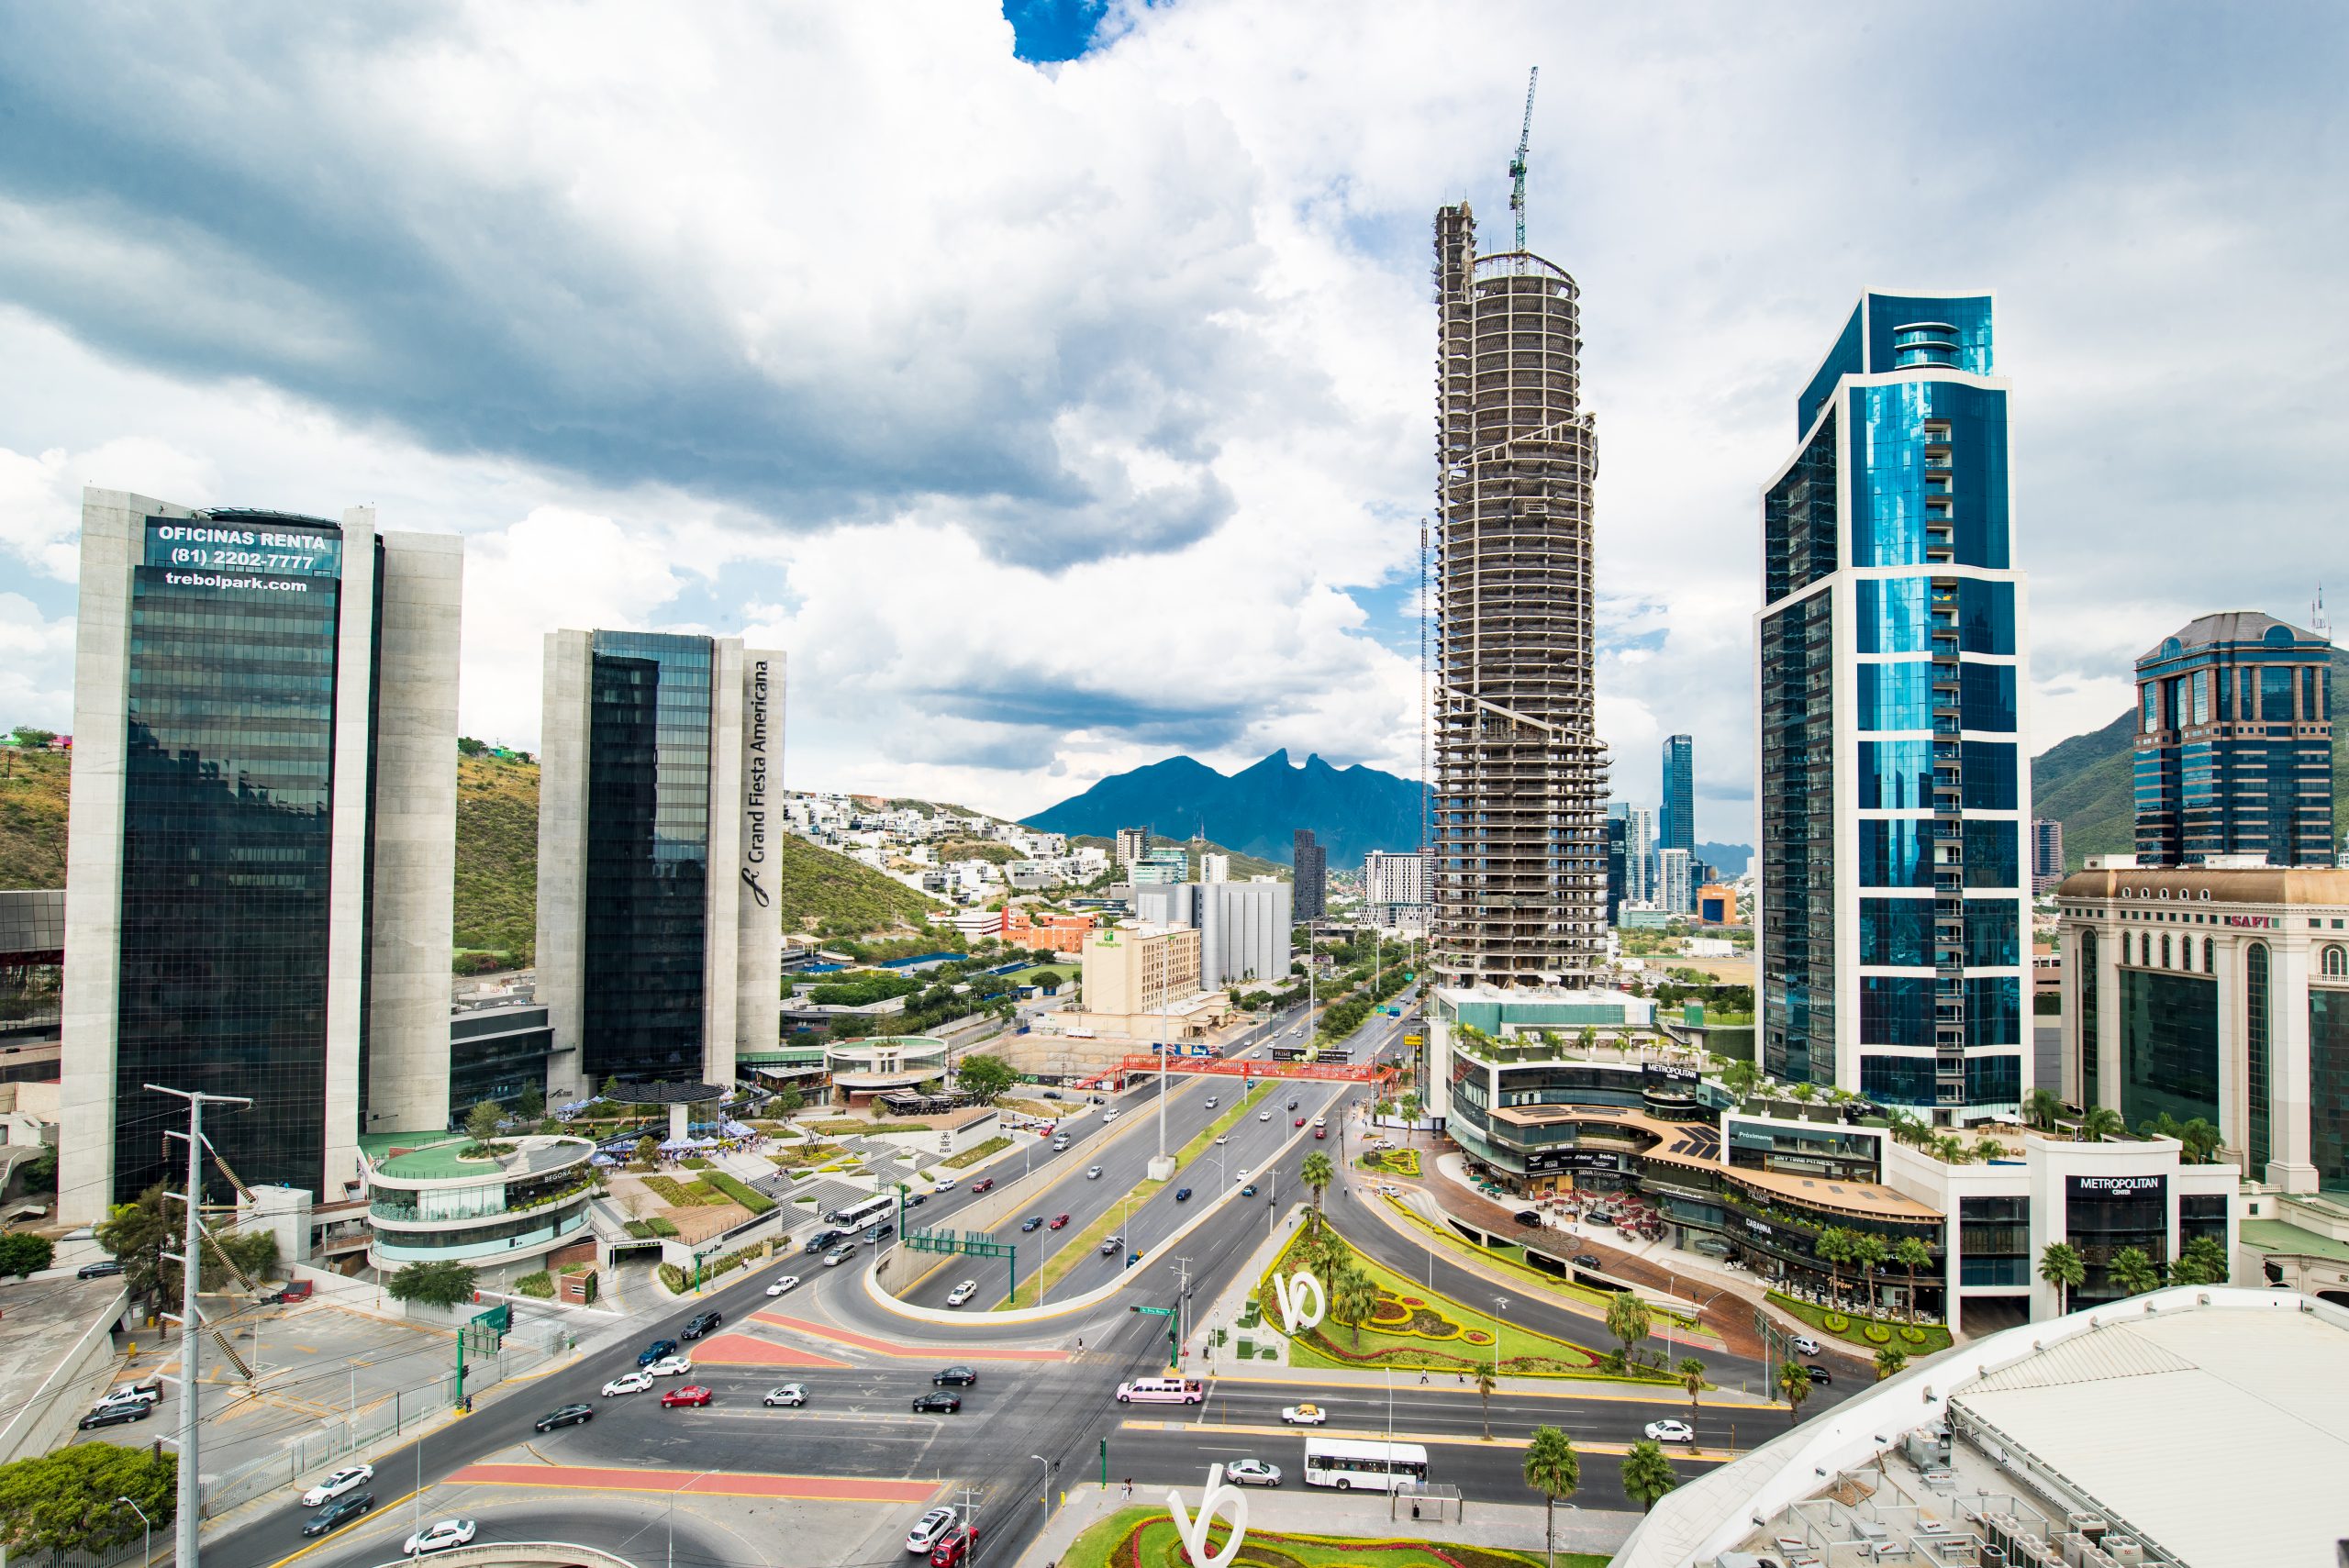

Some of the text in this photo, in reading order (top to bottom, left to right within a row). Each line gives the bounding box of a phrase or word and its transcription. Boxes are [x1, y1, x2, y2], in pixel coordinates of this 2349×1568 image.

[158, 525, 326, 550] OFICINAS RENTA
[172, 548, 315, 570] (81) 2202-7777
[165, 572, 307, 592] trebolpark.com
[748, 660, 769, 863] Grand Fiesta Americana
[2231, 915, 2270, 929] SAFI
[1647, 1064, 1697, 1079] METROPOLITAN
[1806, 1158, 1836, 1167] FITNESS
[1594, 1171, 1620, 1179] Bancomer
[2080, 1177, 2158, 1189] METROPOLITAN
